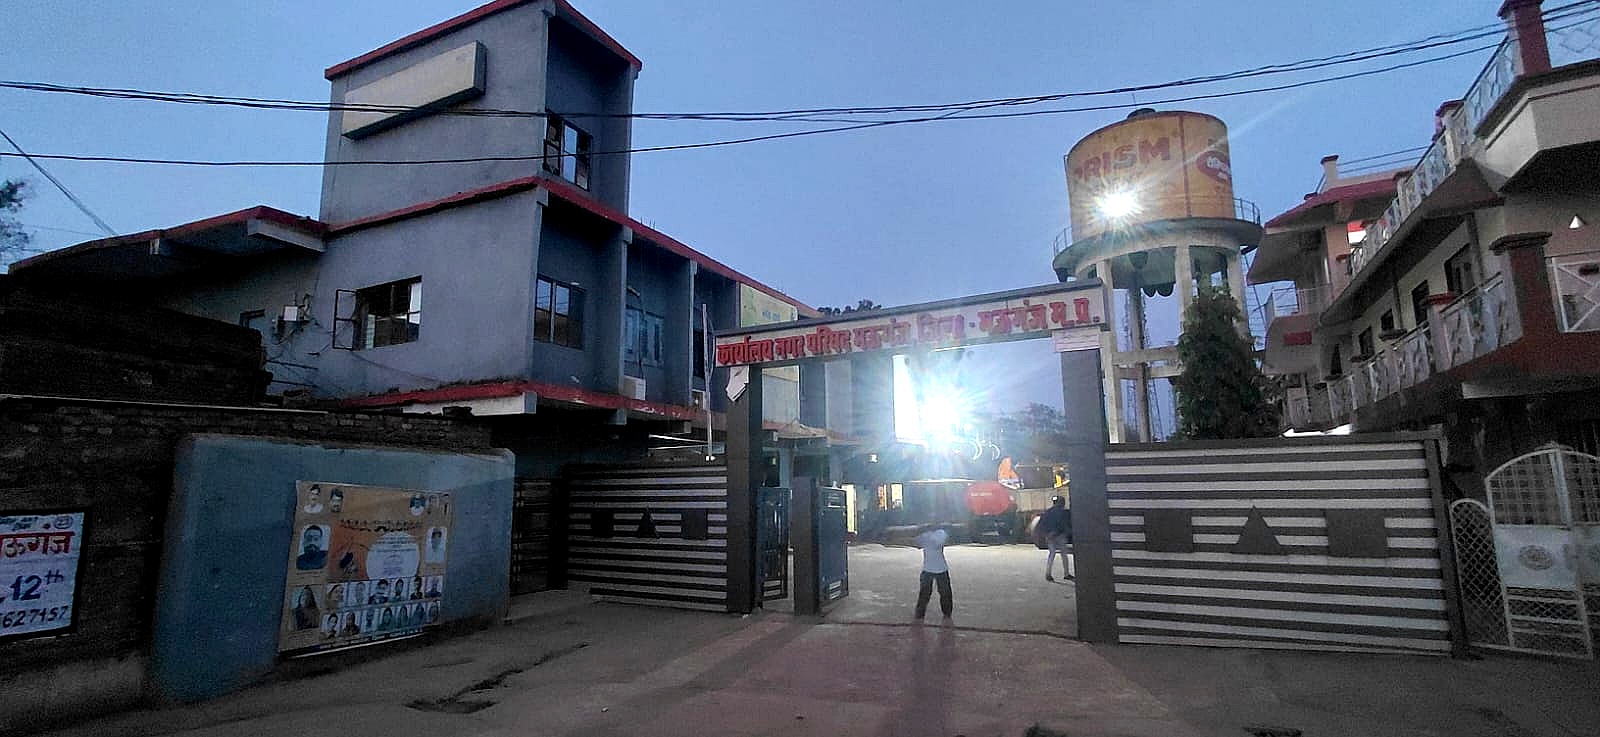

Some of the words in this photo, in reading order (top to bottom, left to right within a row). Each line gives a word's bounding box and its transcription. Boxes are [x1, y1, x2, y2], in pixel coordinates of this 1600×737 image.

[717, 336, 774, 364] कार्यालय
[775, 336, 805, 359] नगर
[977, 299, 1049, 334] मऊगंज
